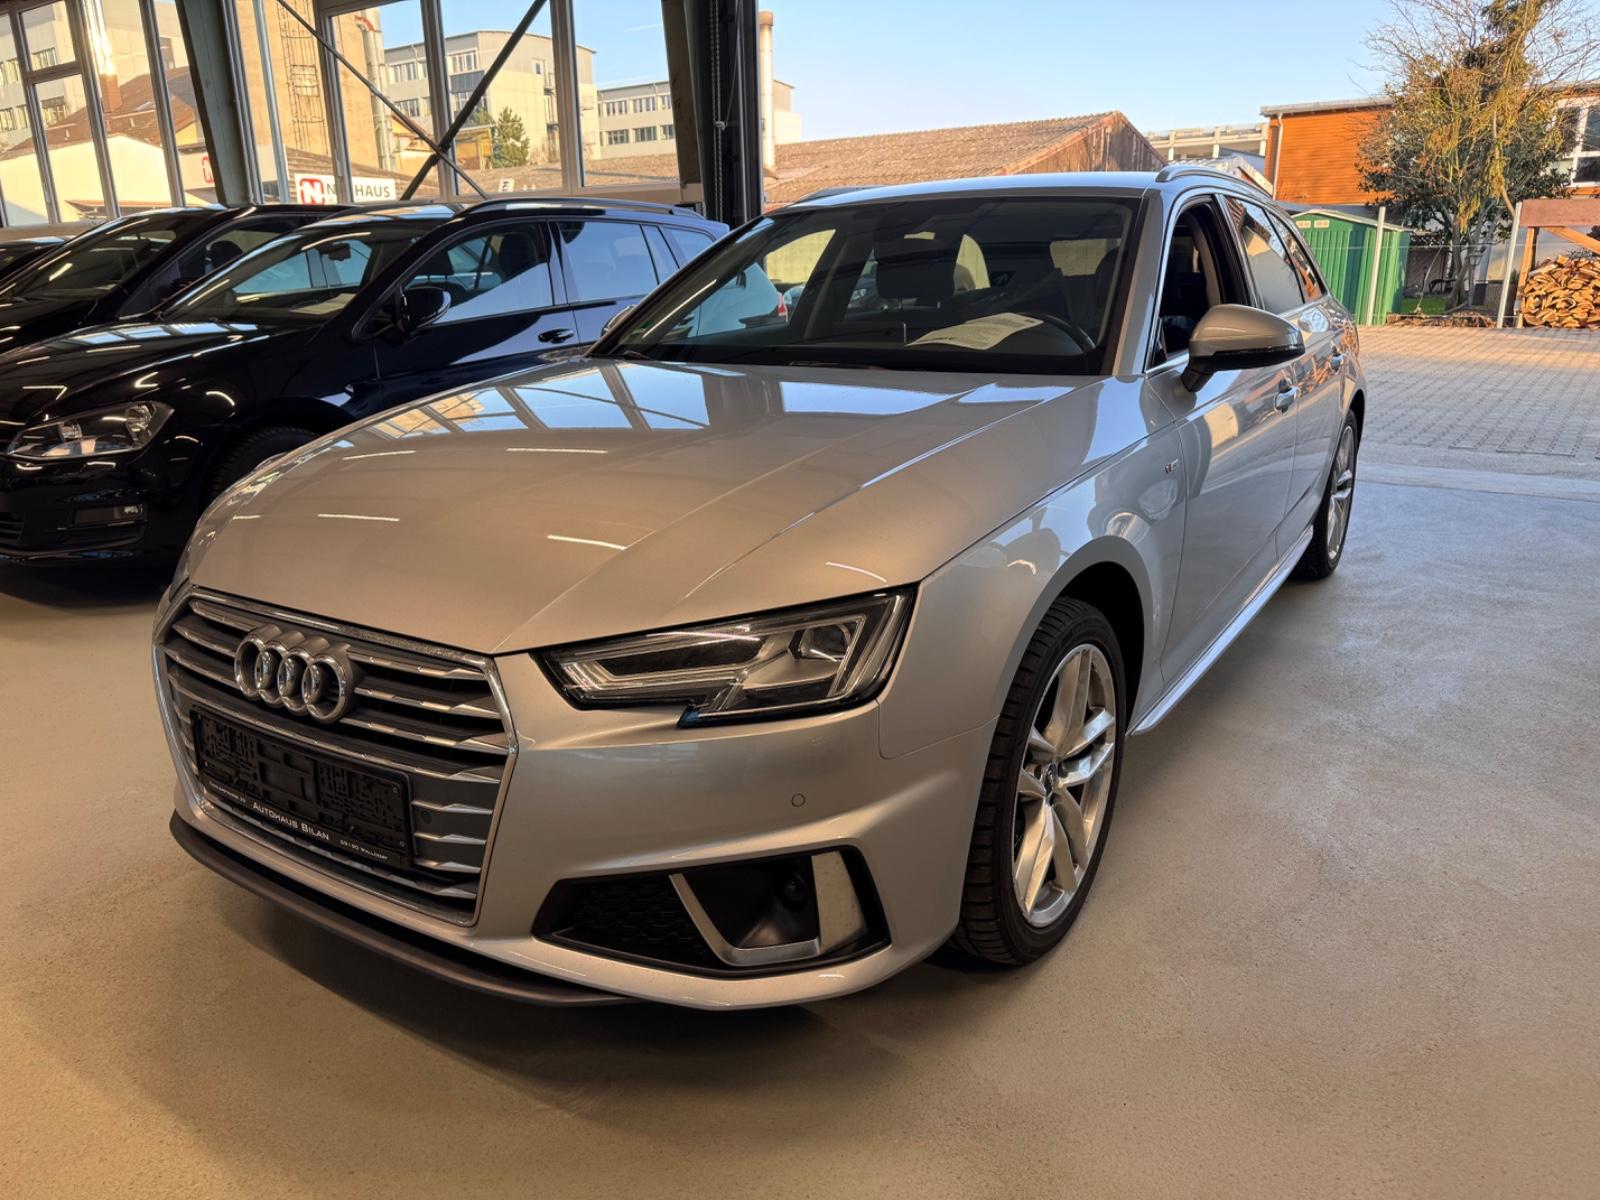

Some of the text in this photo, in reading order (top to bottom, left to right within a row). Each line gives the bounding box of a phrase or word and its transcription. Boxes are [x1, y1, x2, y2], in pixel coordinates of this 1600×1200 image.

[326, 183, 391, 198] NHAUS
[252, 801, 330, 841] AUTOHAUS BILAN
